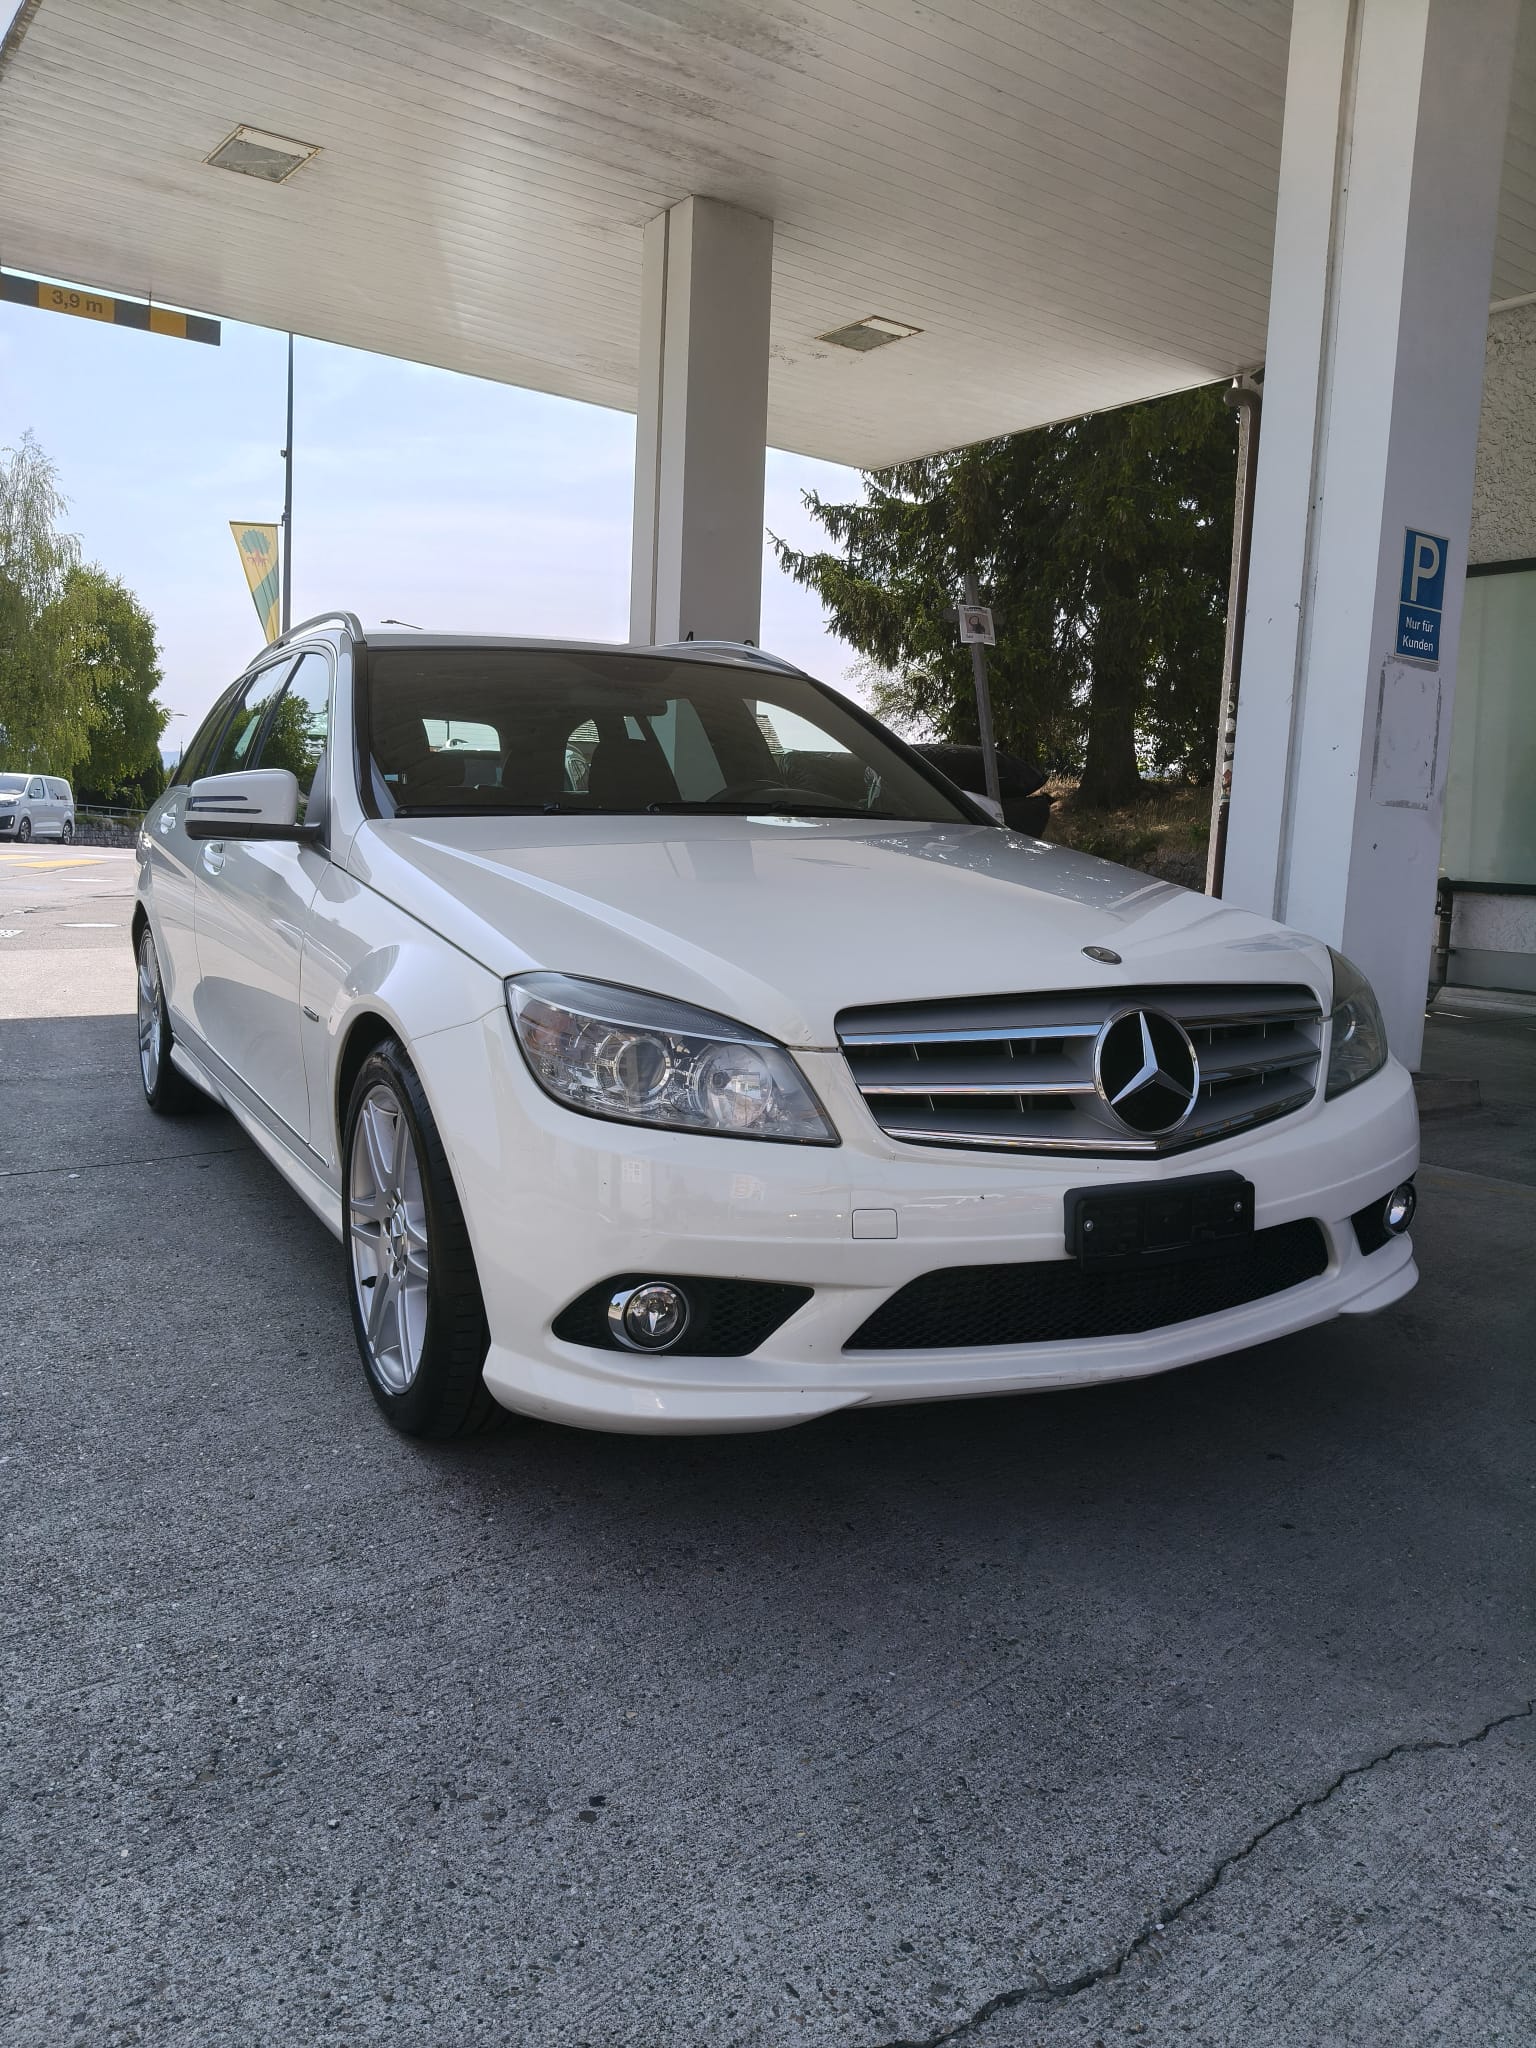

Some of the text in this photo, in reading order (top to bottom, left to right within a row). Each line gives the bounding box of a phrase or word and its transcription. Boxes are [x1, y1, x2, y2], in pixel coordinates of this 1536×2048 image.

[52, 290, 103, 314] 3,9 m
[1410, 535, 1440, 602] P
[1405, 616, 1434, 633] Nur für
[1402, 634, 1434, 652] Kunden
